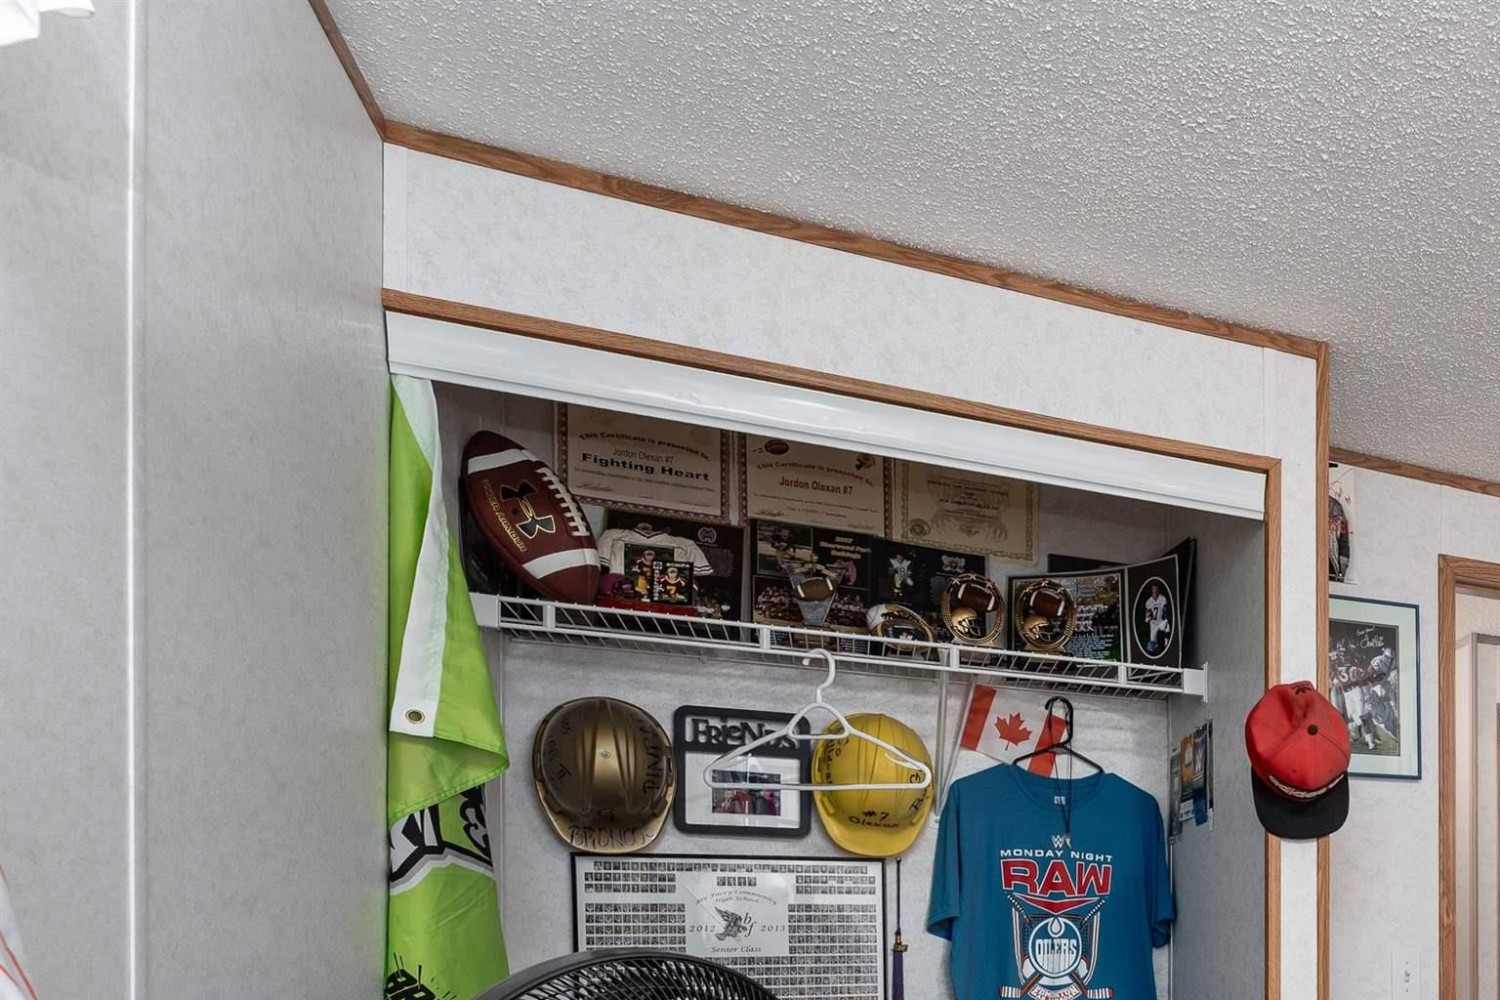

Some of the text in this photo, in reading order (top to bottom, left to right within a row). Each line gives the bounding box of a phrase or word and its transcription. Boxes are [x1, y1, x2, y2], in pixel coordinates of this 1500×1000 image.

[581, 452, 655, 475] Fighting
[661, 465, 710, 481] Heart
[780, 476, 809, 490] Jordon
[1001, 848, 1113, 863] MONDAY NIGHT
[1001, 858, 1113, 898] RAW
[689, 925, 716, 933] 2012
[760, 925, 786, 933] 2013
[711, 945, 738, 953] Senior
[1035, 938, 1078, 957] OILERS
